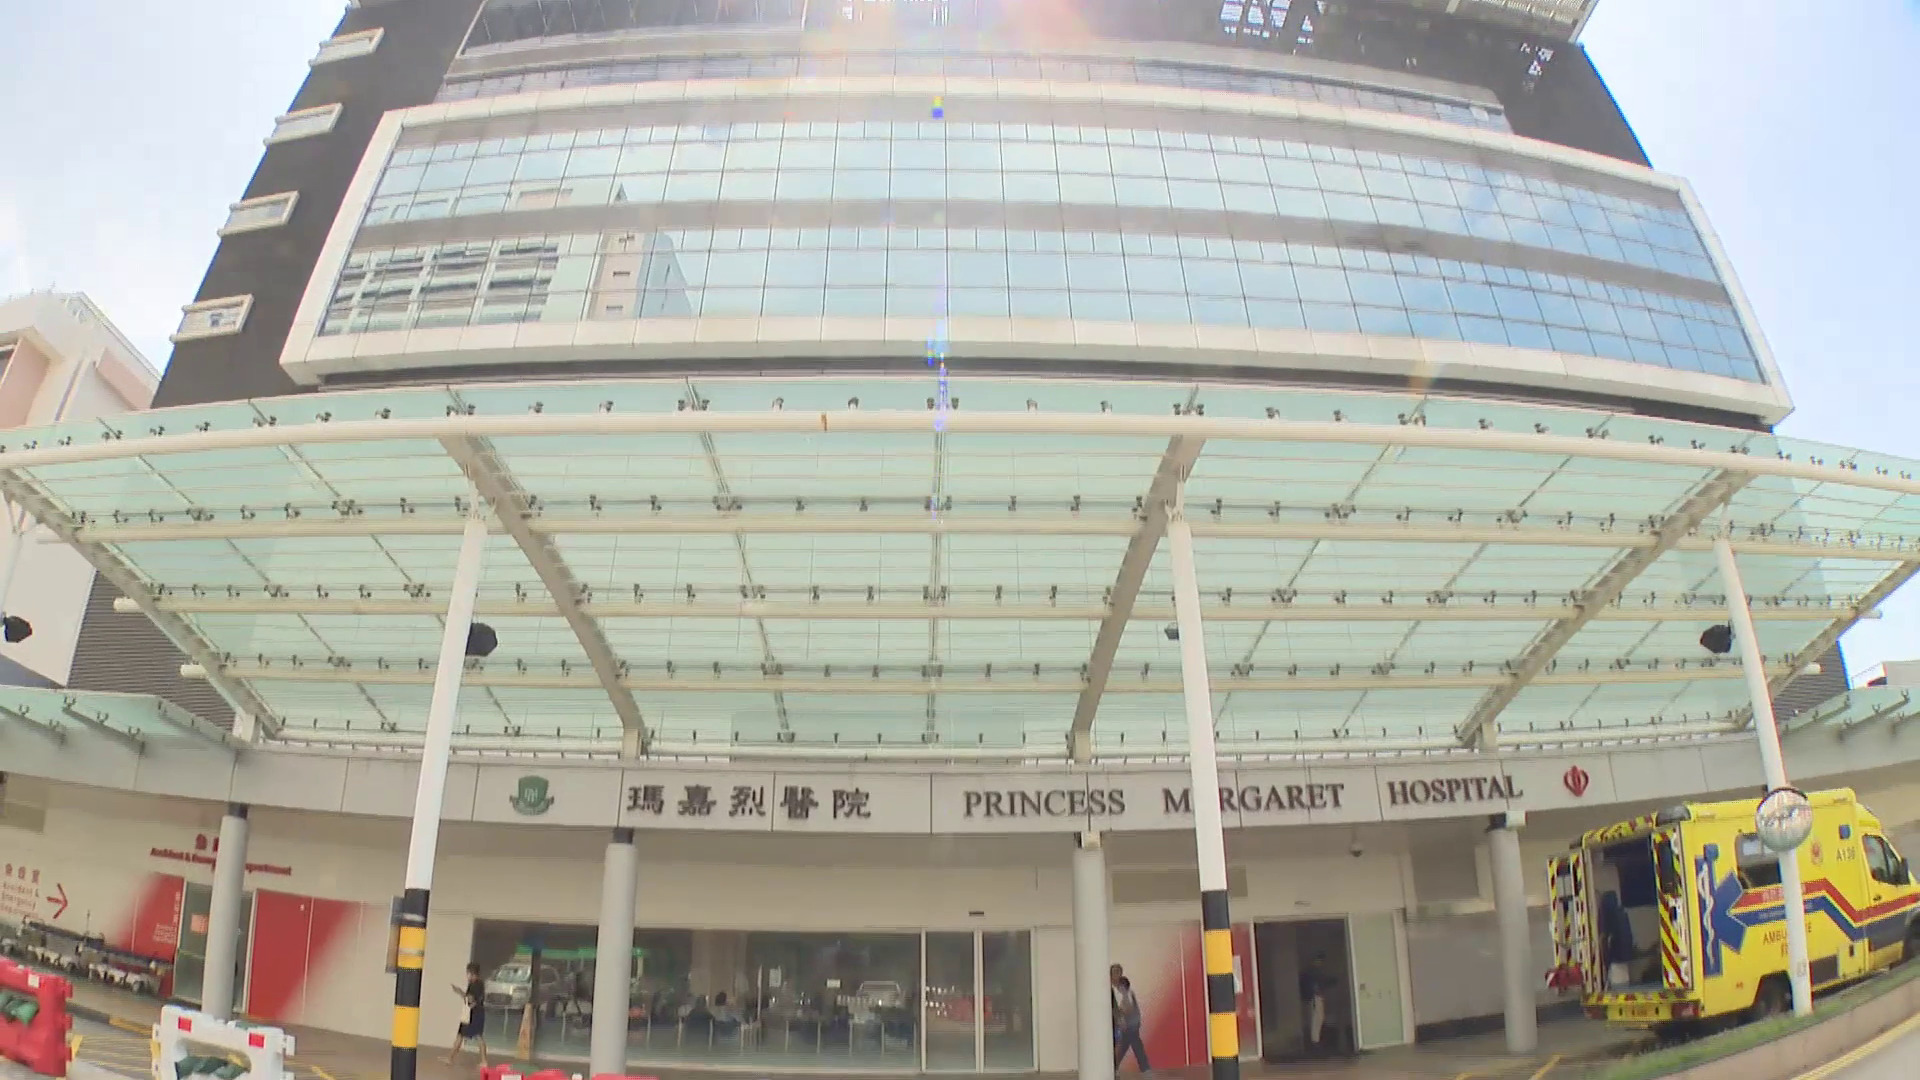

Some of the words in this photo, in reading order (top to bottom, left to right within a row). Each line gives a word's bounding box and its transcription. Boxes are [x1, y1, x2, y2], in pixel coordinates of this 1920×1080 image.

[626, 784, 872, 820] 瑪嘉烈醫院
[963, 787, 1126, 817] PRINCESS
[1162, 782, 1345, 815] MRGARET
[1386, 775, 1524, 807] HOSPITAL
